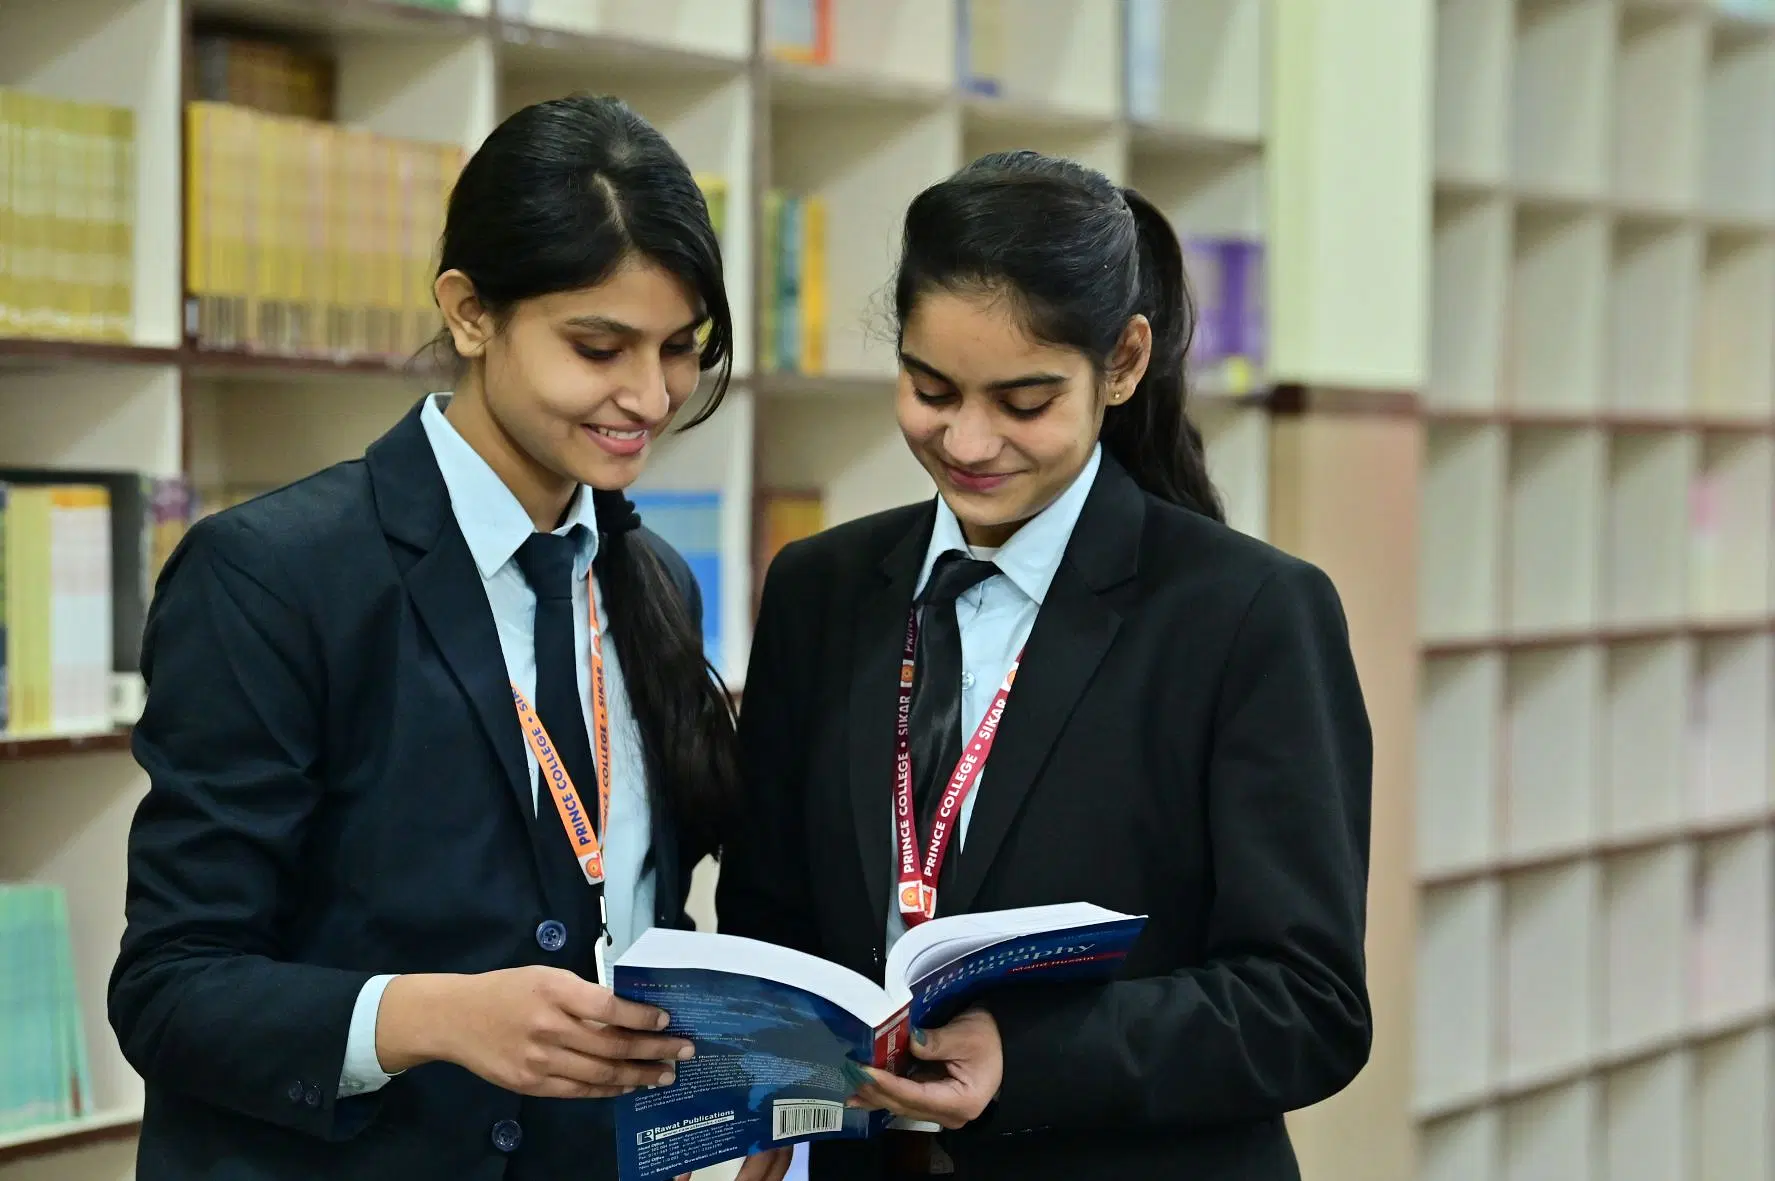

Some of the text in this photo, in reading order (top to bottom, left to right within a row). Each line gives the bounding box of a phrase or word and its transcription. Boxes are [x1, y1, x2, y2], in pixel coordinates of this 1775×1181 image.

[532, 727, 567, 790] COLLEGE
[898, 695, 914, 874] PRINCE COLLEGE SIKAR
[924, 698, 1006, 877] PRINCE COLLEGE SIKAR
[562, 793, 591, 846] PRINCE
[654, 1121, 680, 1134] Rawat
[683, 1109, 735, 1126] Publications
